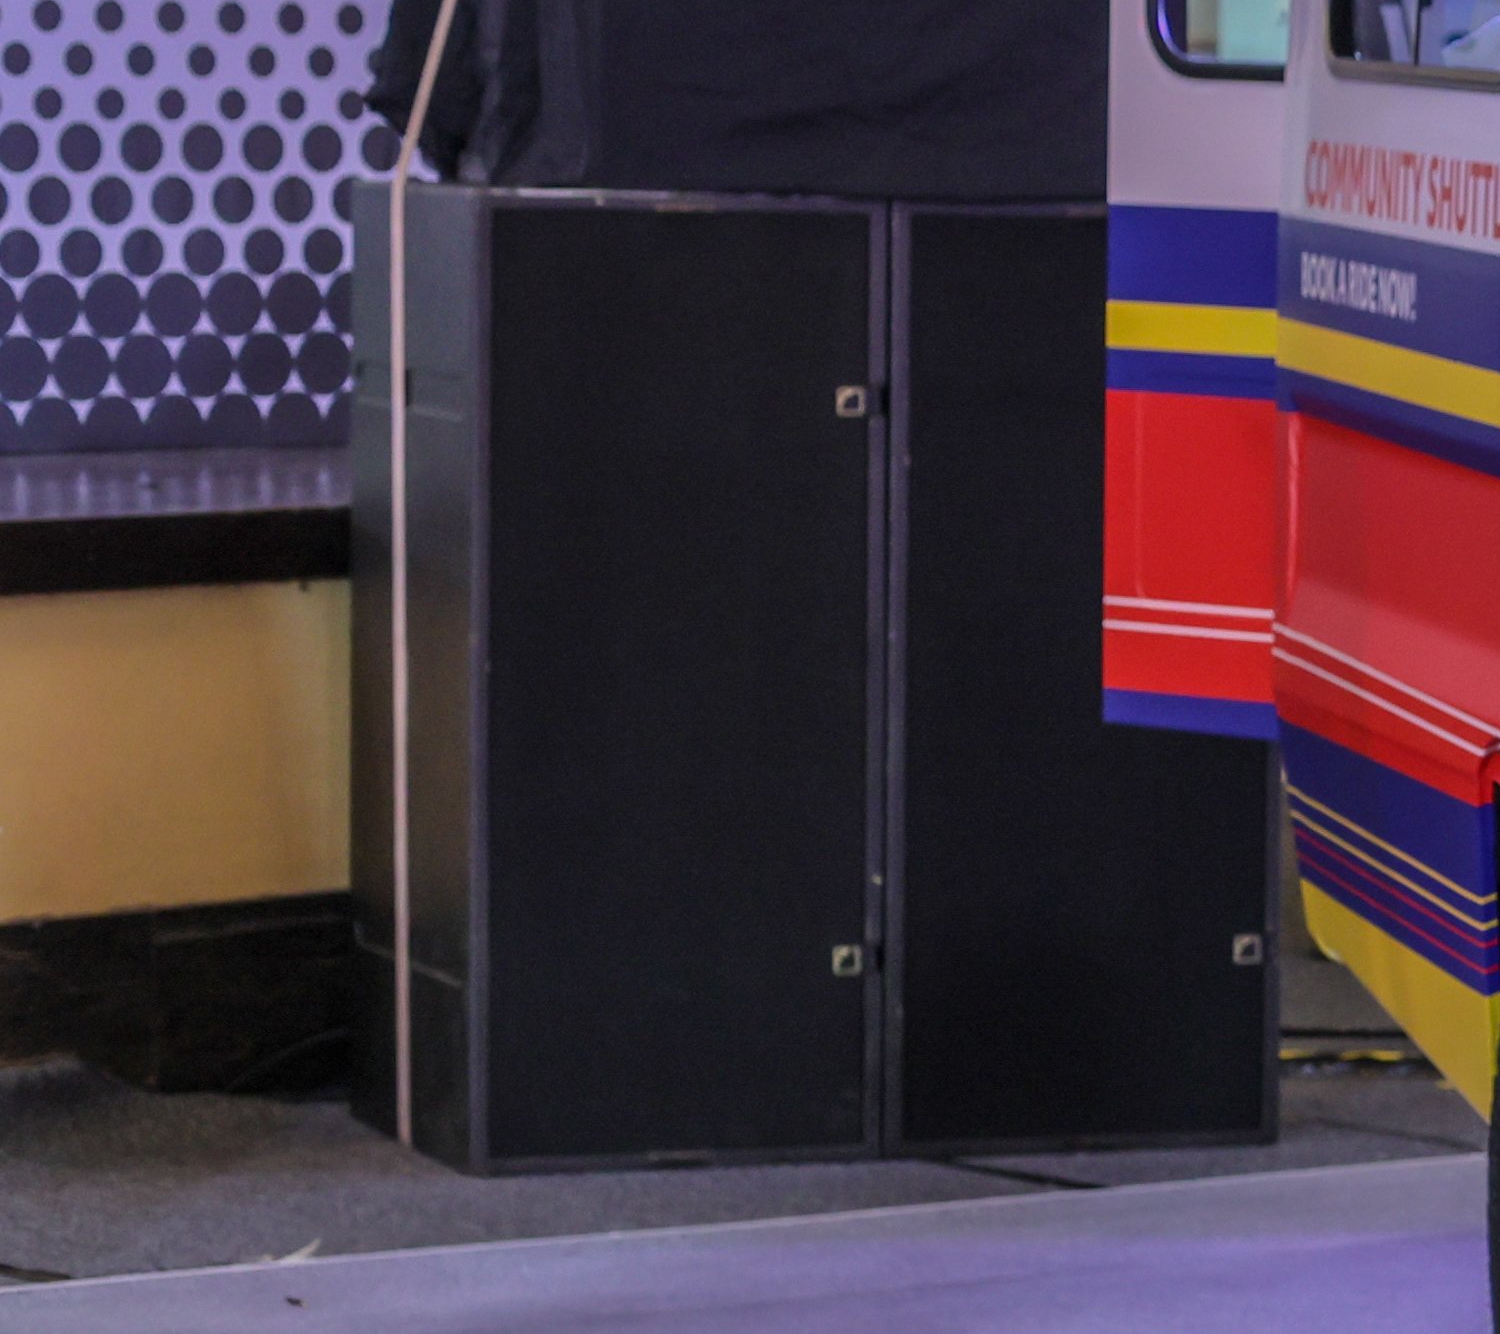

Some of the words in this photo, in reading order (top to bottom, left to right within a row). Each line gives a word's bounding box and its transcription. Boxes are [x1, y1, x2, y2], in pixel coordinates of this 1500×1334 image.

[1305, 139, 1425, 226] COMMUNITY
[1301, 251, 1338, 303] BOOK
[1348, 260, 1377, 313] RIDE
[1378, 267, 1417, 321] NOW!
